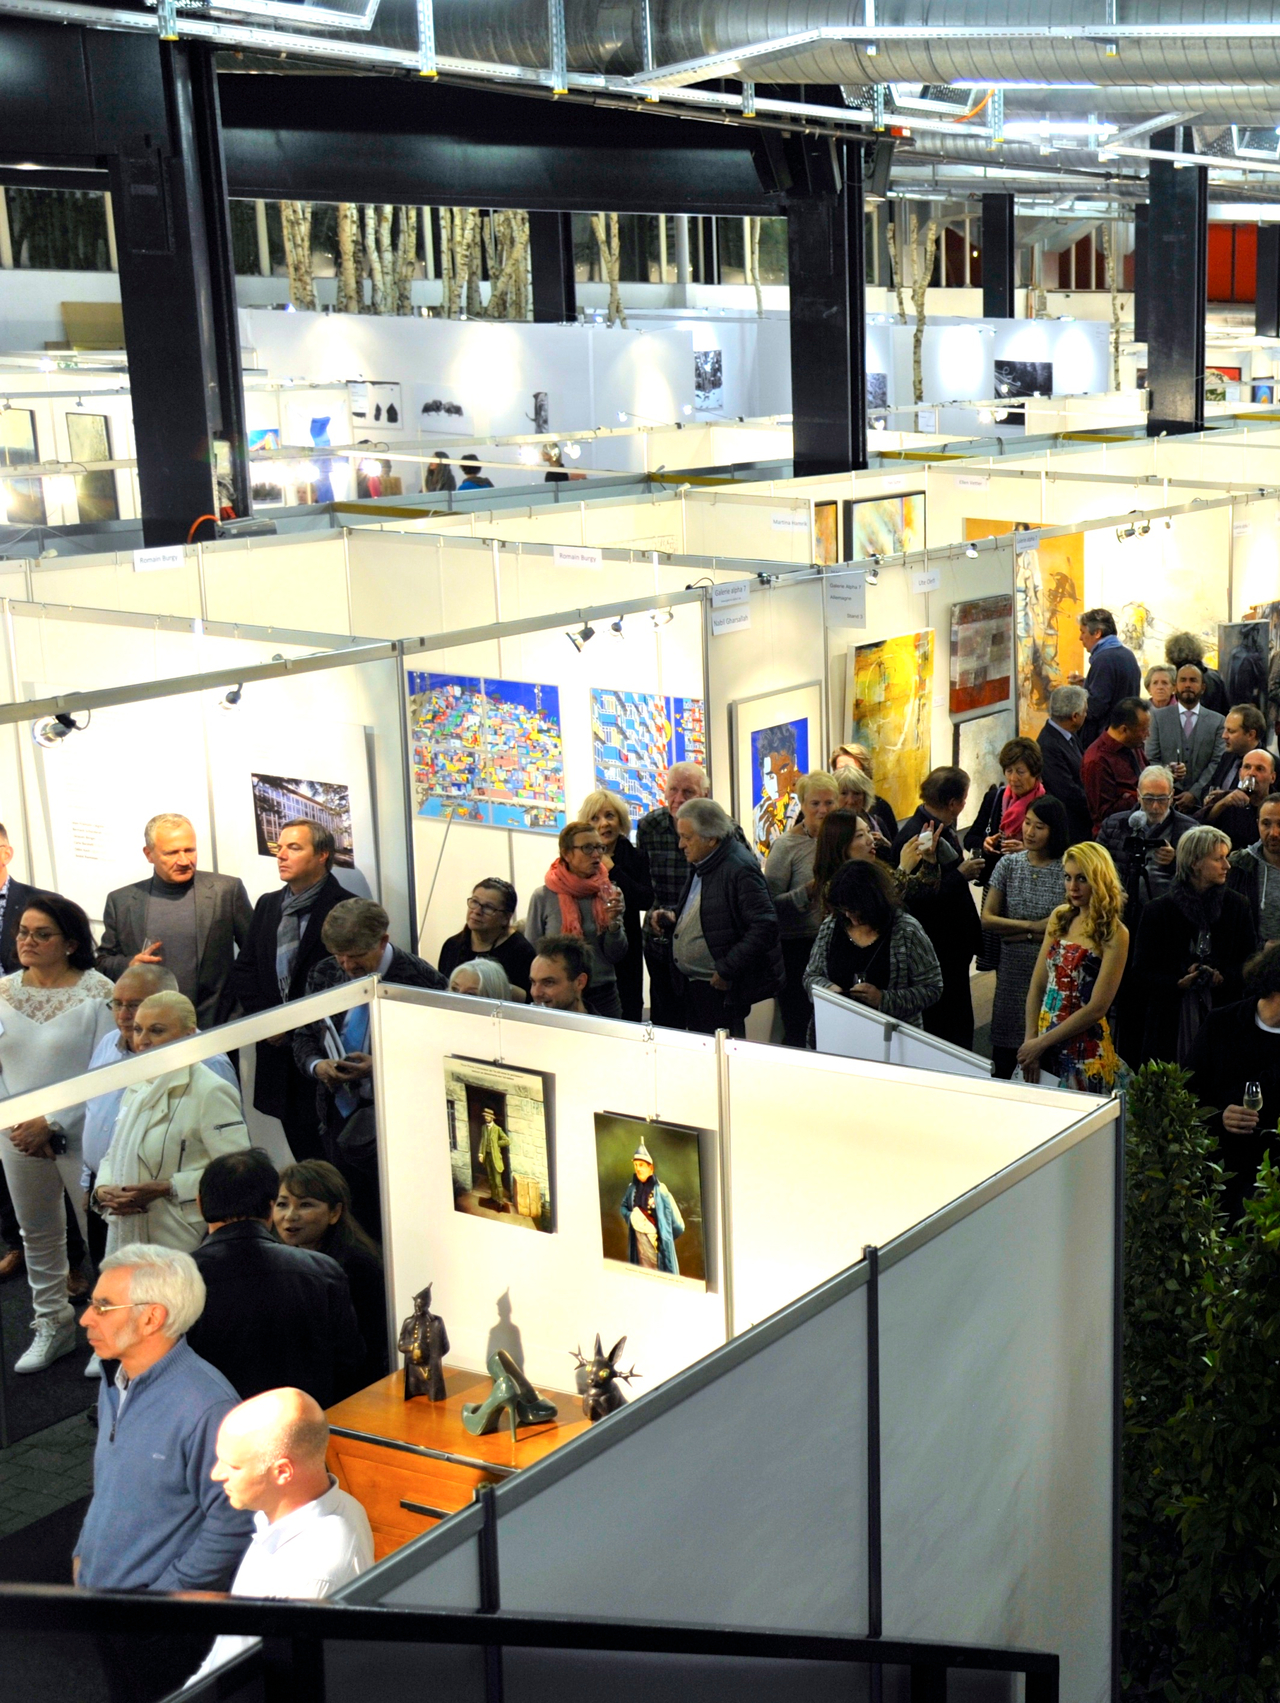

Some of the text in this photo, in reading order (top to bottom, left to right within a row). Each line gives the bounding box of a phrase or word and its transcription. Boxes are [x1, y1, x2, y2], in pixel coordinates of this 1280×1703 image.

[139, 556, 161, 564] Romain
[559, 552, 580, 560] Romain
[714, 587, 730, 597] Galerie
[730, 586, 743, 595] alpha
